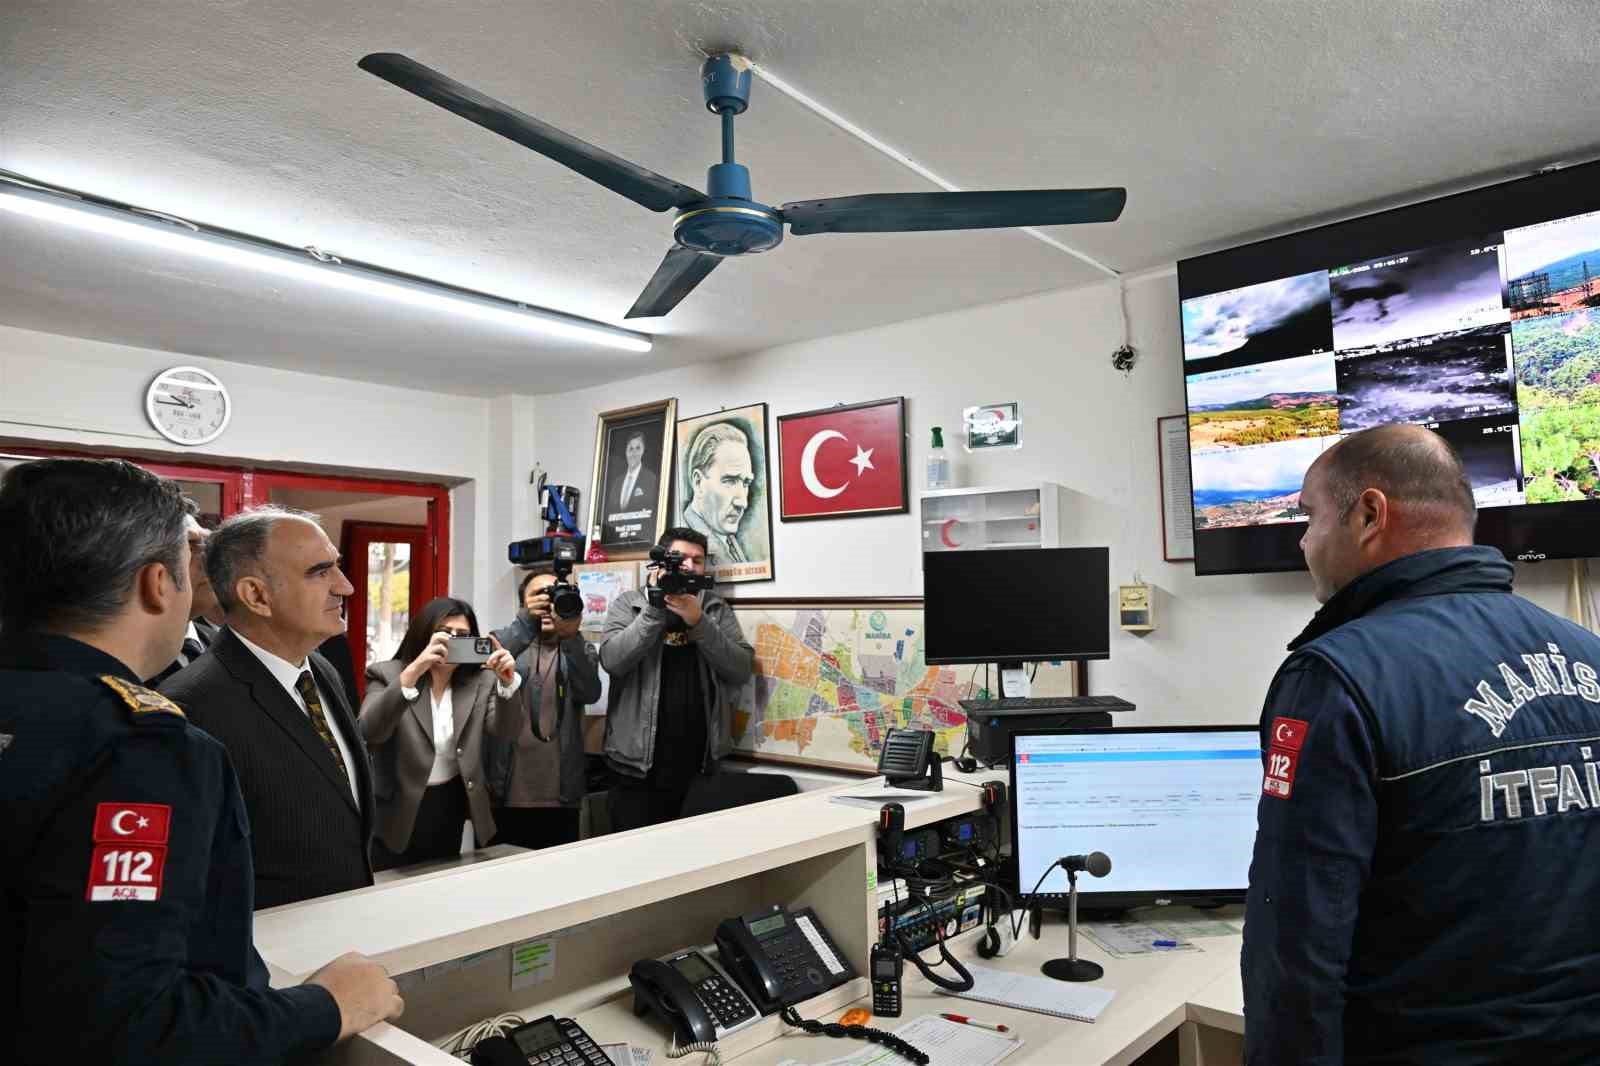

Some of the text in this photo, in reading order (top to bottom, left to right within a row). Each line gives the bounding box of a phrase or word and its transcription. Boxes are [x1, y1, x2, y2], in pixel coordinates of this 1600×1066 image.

[1269, 753, 1291, 779] 112
[1479, 746, 1600, 822] İTFAİ
[103, 850, 154, 883] 112
